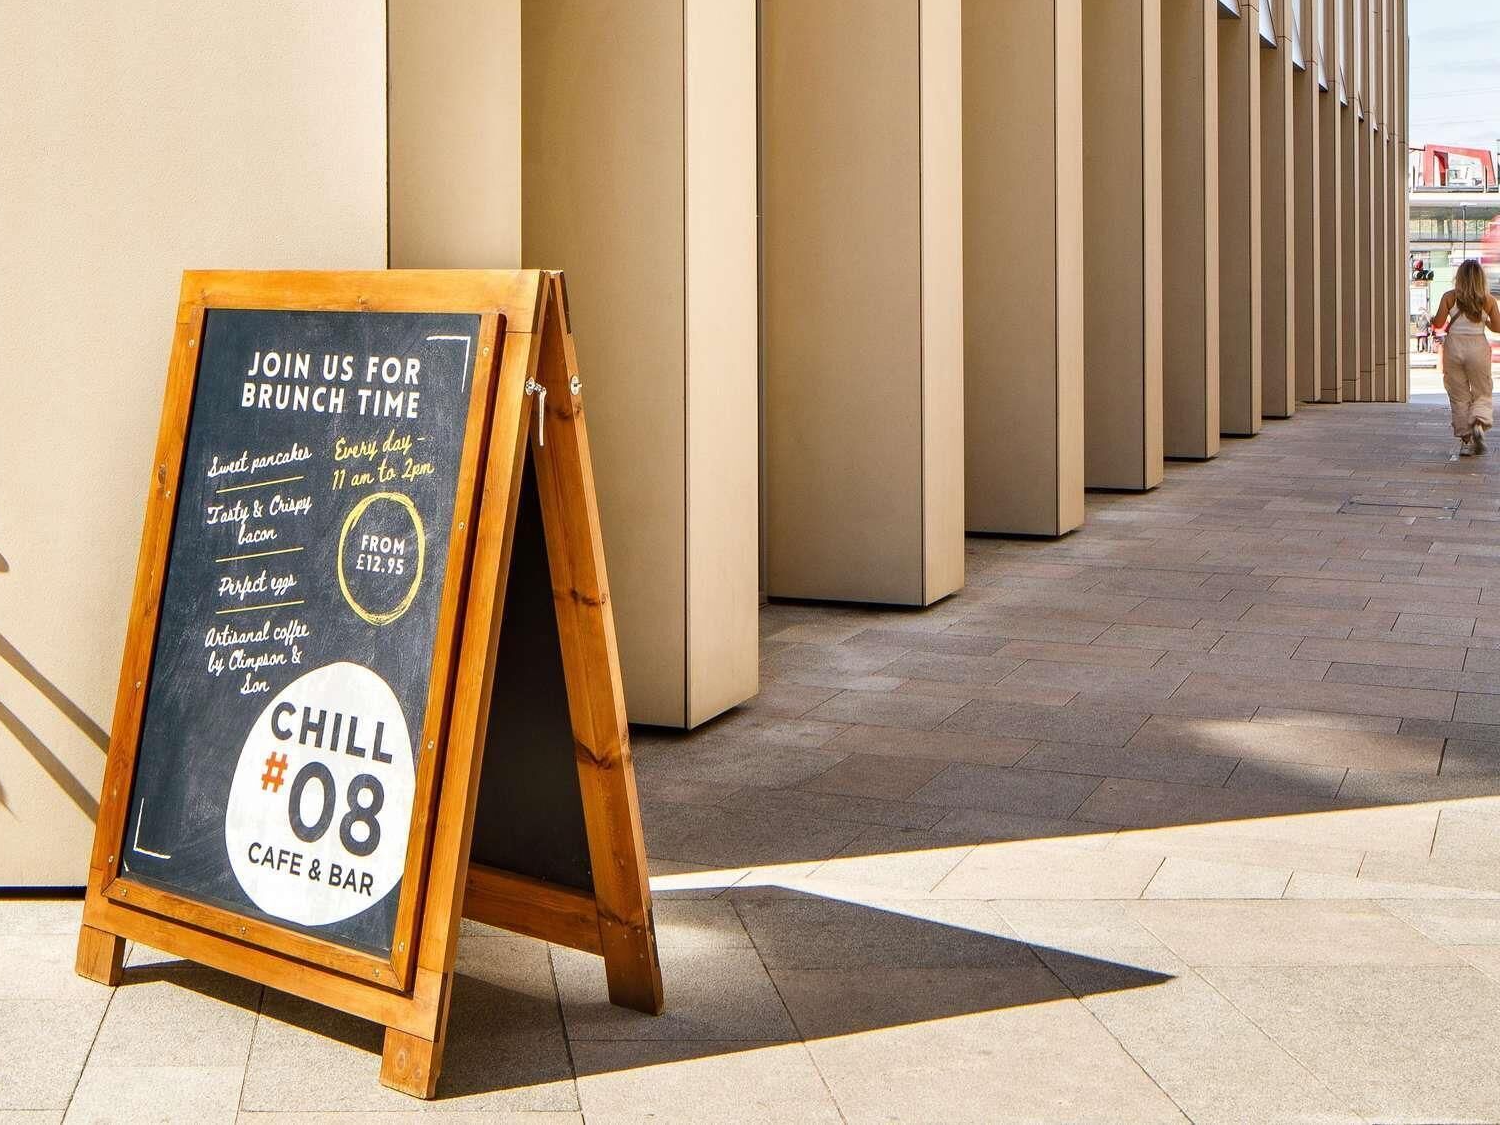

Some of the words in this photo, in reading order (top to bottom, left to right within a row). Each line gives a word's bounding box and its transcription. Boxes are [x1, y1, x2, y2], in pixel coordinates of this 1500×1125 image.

[248, 352, 311, 379] JOIN
[322, 355, 354, 382] US
[367, 357, 421, 385] FOR
[241, 383, 345, 414] BRUNCH
[358, 390, 420, 419] TIME
[207, 451, 250, 477] Sweet
[251, 443, 312, 473] pancakes
[334, 437, 377, 461] Every
[382, 429, 412, 454] day
[350, 471, 375, 486] am
[378, 459, 395, 483] to
[400, 458, 435, 483] 2pm
[206, 499, 250, 525] Tasty
[253, 499, 263, 518] &
[269, 493, 313, 516] Crispy
[238, 525, 277, 545] bacon
[360, 534, 406, 556] FROM
[355, 554, 405, 576] £12.95
[218, 570, 267, 601] Perfect
[270, 574, 297, 596] eggs
[204, 620, 270, 648] Artisanal
[273, 619, 310, 646] coffee
[207, 650, 225, 677] by
[228, 648, 288, 672] Climpson
[291, 645, 303, 664] &
[240, 672, 270, 695] Son
[271, 701, 393, 765] CHILL
[248, 841, 303, 878] CAFE
[307, 858, 322, 881] &
[328, 863, 375, 897] BAR
